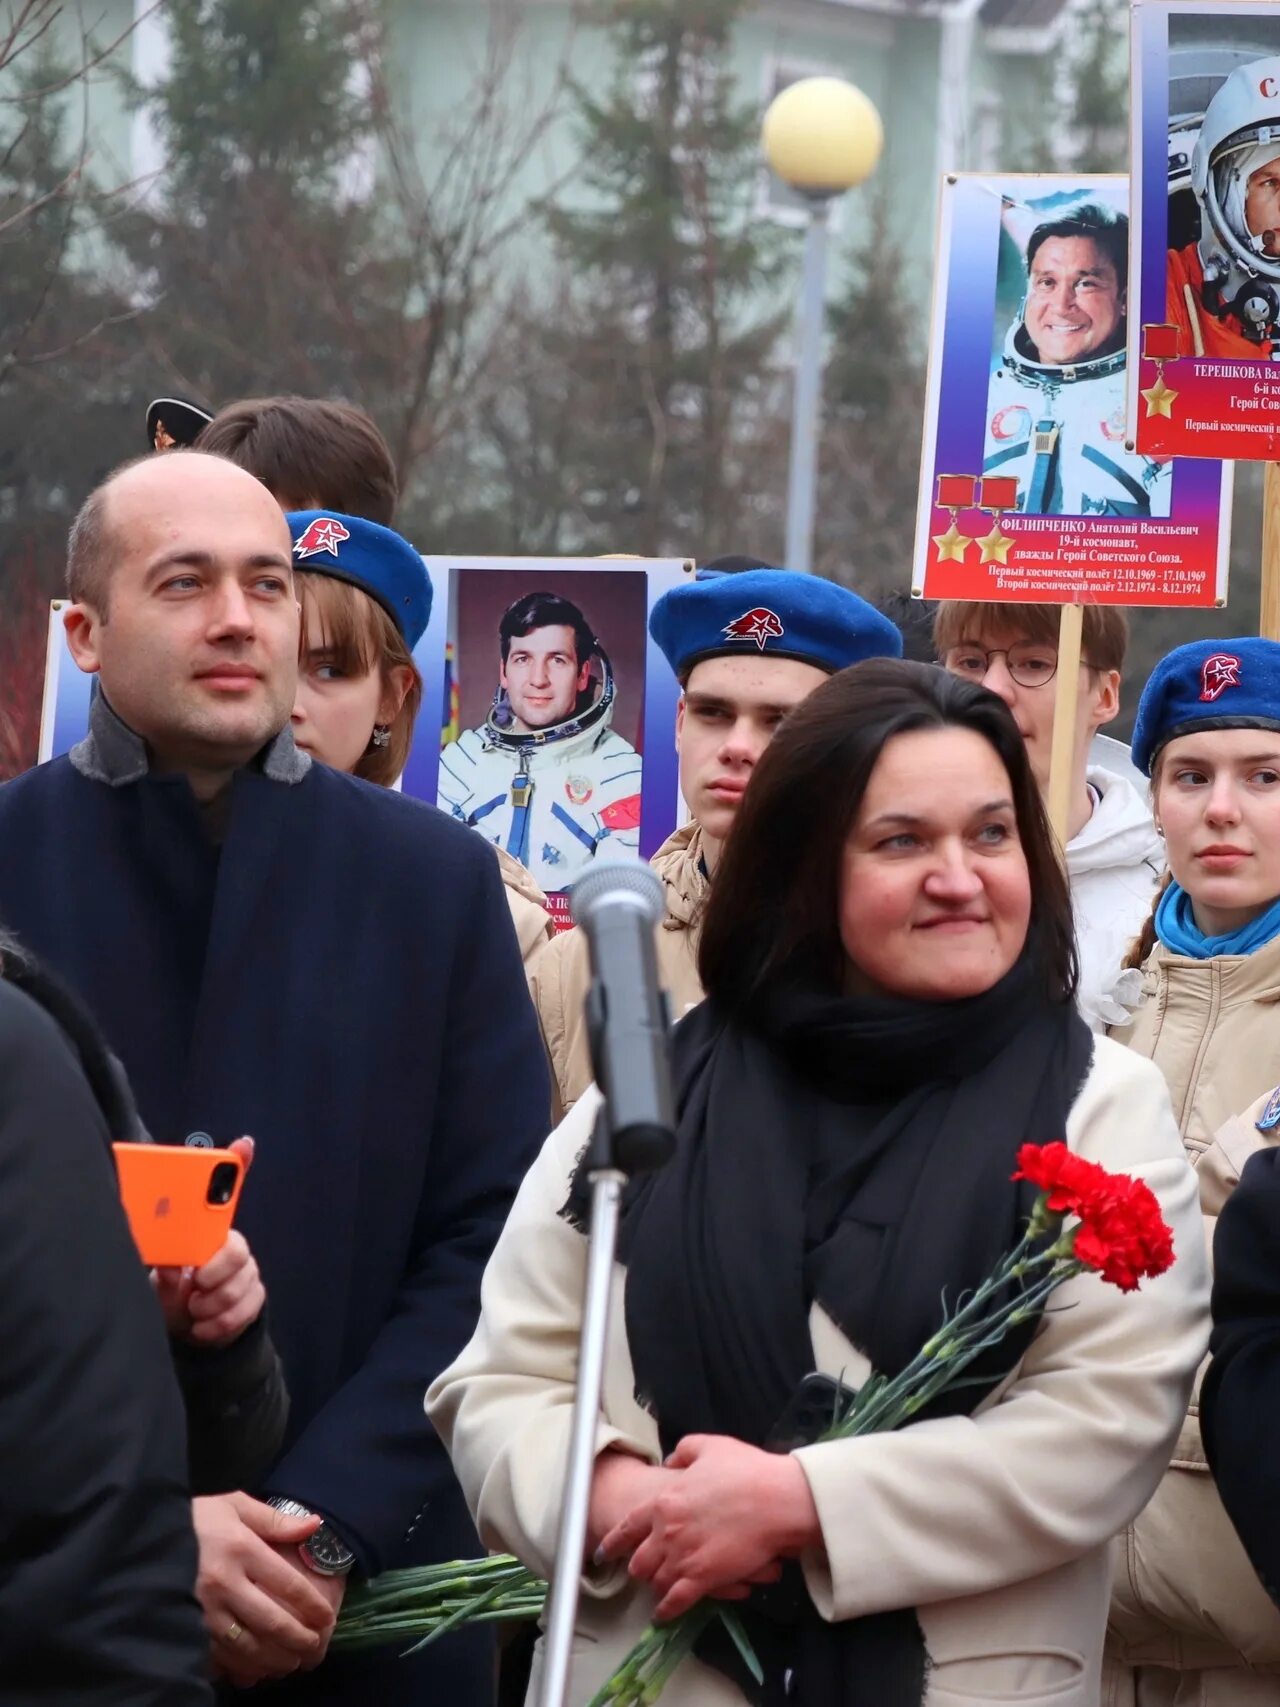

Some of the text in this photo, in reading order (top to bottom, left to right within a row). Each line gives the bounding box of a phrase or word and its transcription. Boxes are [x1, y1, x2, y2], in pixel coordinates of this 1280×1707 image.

[1194, 364, 1262, 379] ТЕРЕШКОВА
[1254, 382, 1269, 395] 6-й
[1230, 396, 1259, 412] Герой
[1185, 418, 1218, 433] Первый
[1220, 422, 1274, 434] космический
[1001, 518, 1199, 536] ФИЛИПЧЕНКО Анатолий Васильевич
[1059, 534, 1139, 550] 19-й космонавт,
[1013, 549, 1183, 564] дважды Герой Советского Союза.
[988, 565, 1025, 578] Первый
[1026, 567, 1084, 579] космический
[1085, 569, 1111, 579] полёт
[1113, 568, 1156, 580] 12.10.1969
[1164, 570, 1206, 582] 17.10.1969
[997, 577, 1029, 591] Второй
[1031, 580, 1088, 591] космический
[1090, 583, 1115, 593] полёт
[1117, 581, 1156, 593] 2.12.1974
[1162, 583, 1201, 594] 8.12.1974
